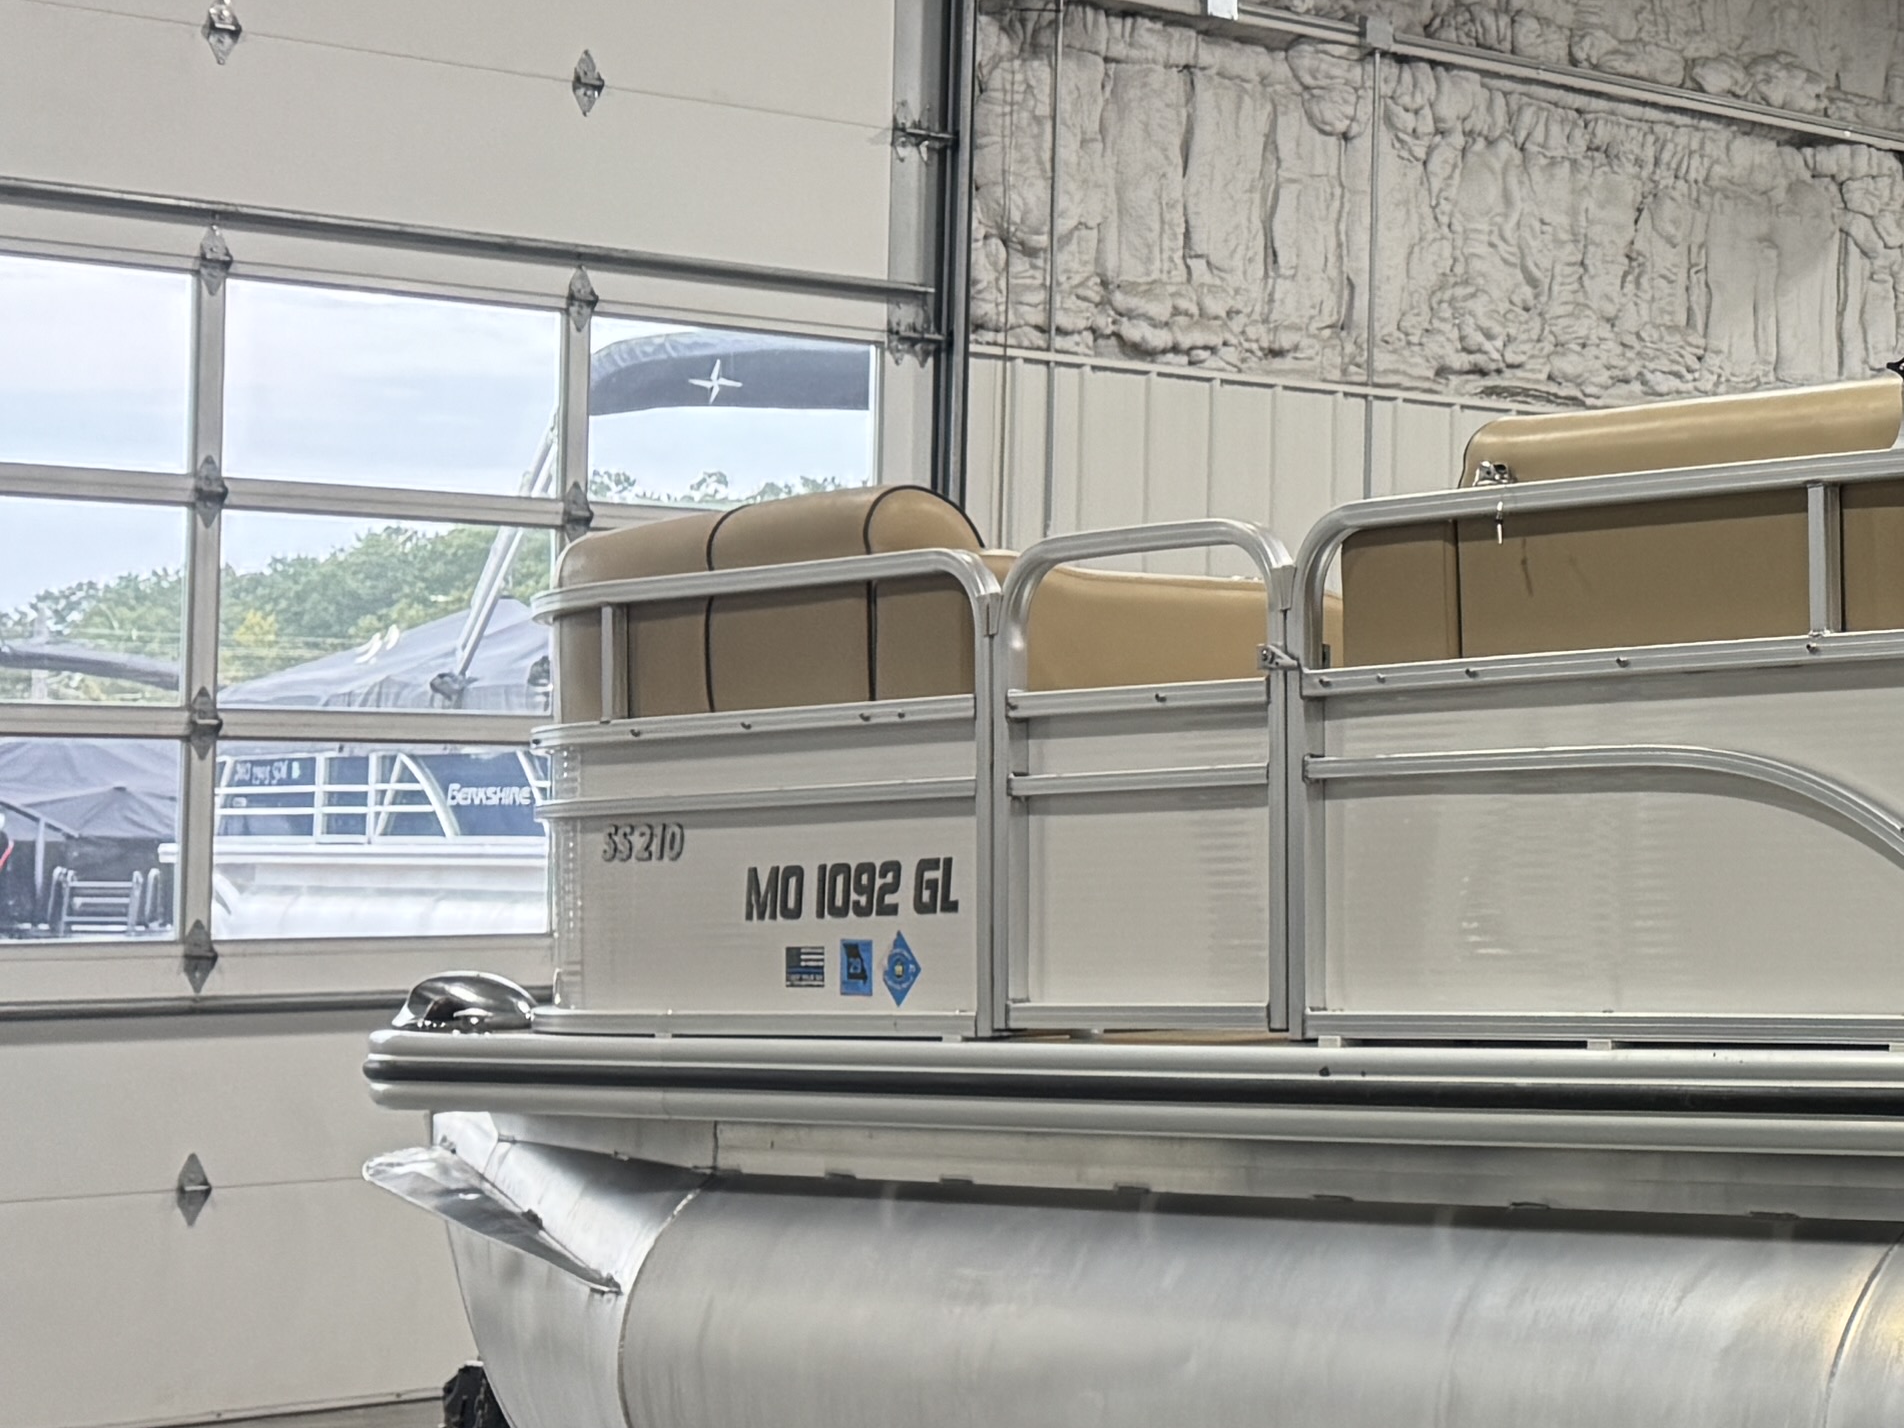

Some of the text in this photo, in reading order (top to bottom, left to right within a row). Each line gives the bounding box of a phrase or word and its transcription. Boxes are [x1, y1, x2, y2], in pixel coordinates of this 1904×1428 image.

[601, 822, 685, 864] SS210
[745, 856, 960, 922] MO 1092 GL
